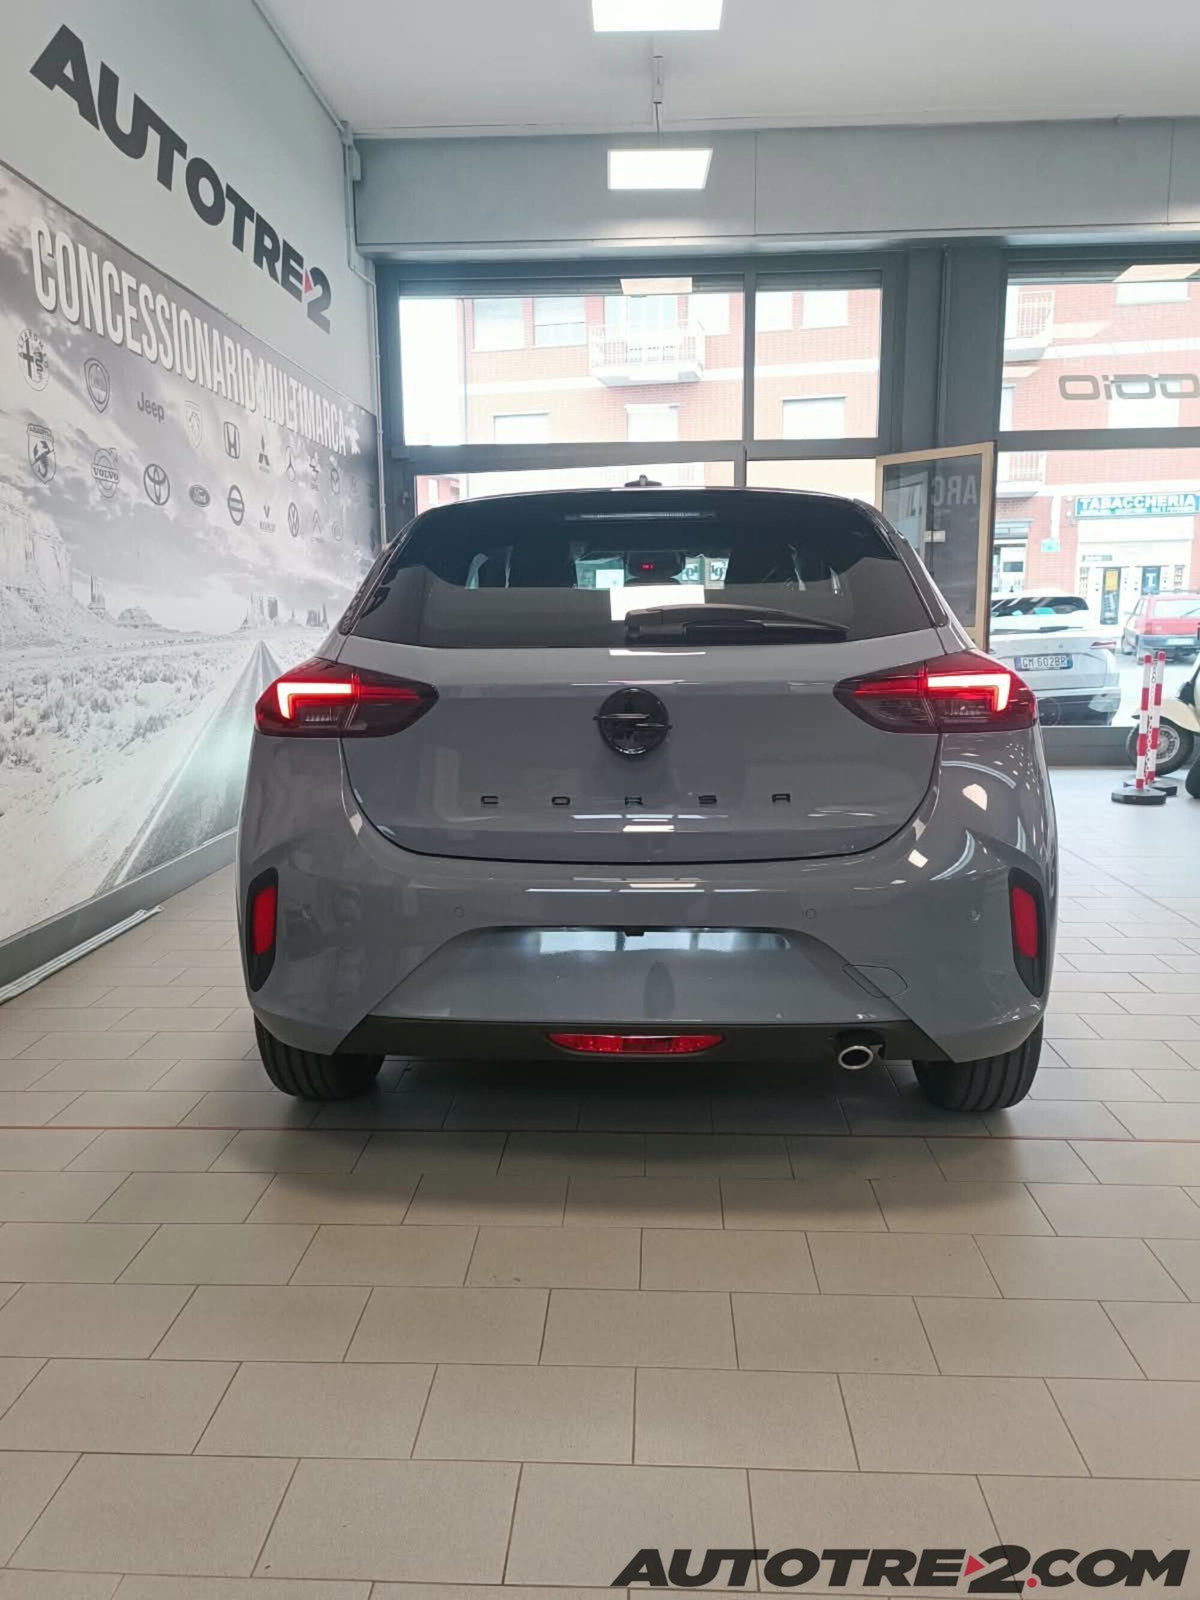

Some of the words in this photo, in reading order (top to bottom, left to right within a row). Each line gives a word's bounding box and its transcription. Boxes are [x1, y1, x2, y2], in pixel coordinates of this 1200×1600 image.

[31, 218, 257, 413] CONCESSIONARIO
[257, 358, 348, 457] MULTIMARCA
[137, 391, 165, 424] Jeep
[93, 466, 120, 481] VOLVO
[1080, 494, 1196, 510] TABACCHERIA
[481, 792, 791, 806] CORSA
